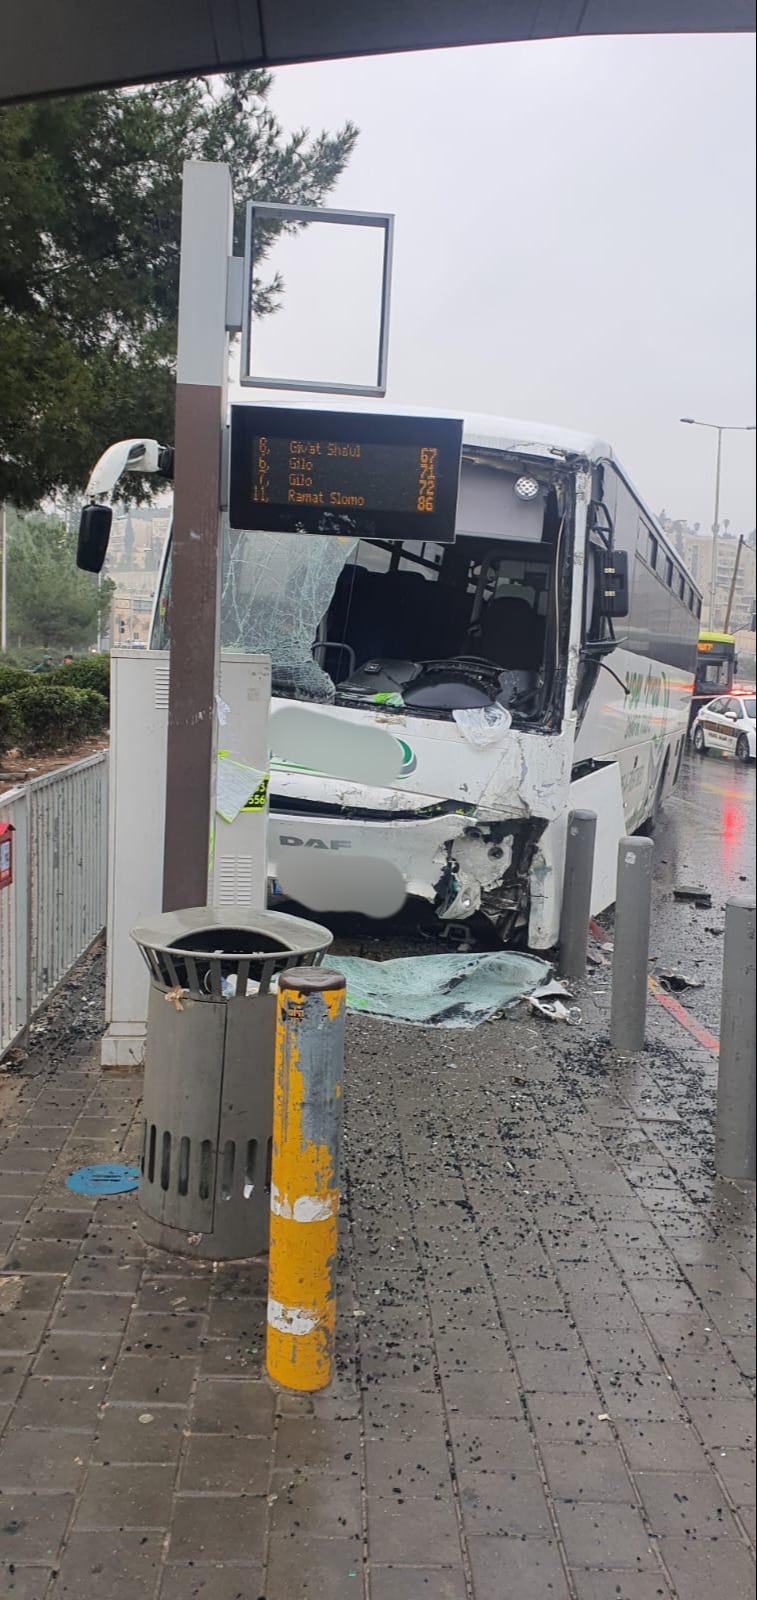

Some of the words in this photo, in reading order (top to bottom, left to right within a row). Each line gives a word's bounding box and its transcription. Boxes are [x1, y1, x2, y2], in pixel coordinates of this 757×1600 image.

[289, 441, 322, 455] Givat
[420, 448, 437, 463] 67
[289, 457, 313, 471] Gilo
[420, 464, 436, 479] 71
[289, 473, 313, 487] Gilo
[419, 480, 435, 496] 72
[288, 489, 324, 504] Ramat
[329, 492, 365, 506] Slomo
[417, 496, 434, 512] 86
[279, 835, 352, 850] DAF
